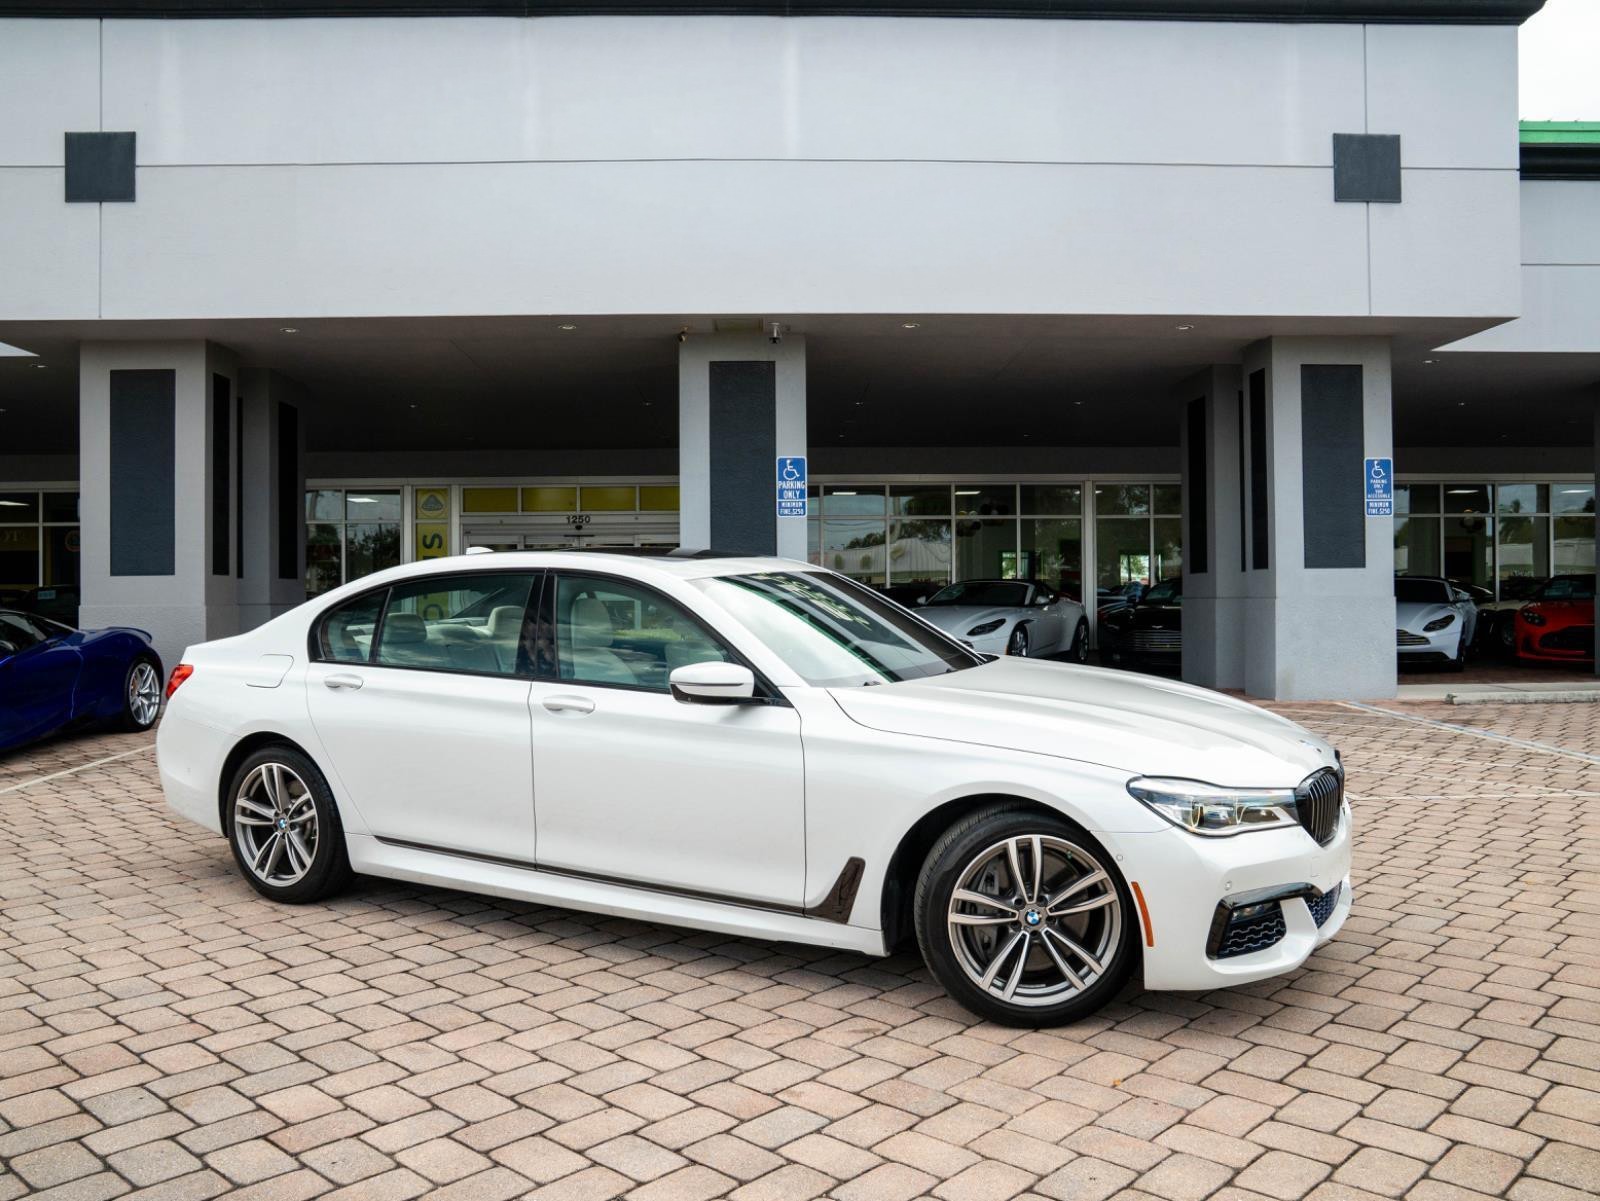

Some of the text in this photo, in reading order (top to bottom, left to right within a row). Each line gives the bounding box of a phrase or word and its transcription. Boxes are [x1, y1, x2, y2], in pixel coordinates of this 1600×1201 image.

[778, 480, 805, 490] PARKING
[783, 490, 800, 499] ONLY
[566, 515, 591, 524] 1250
